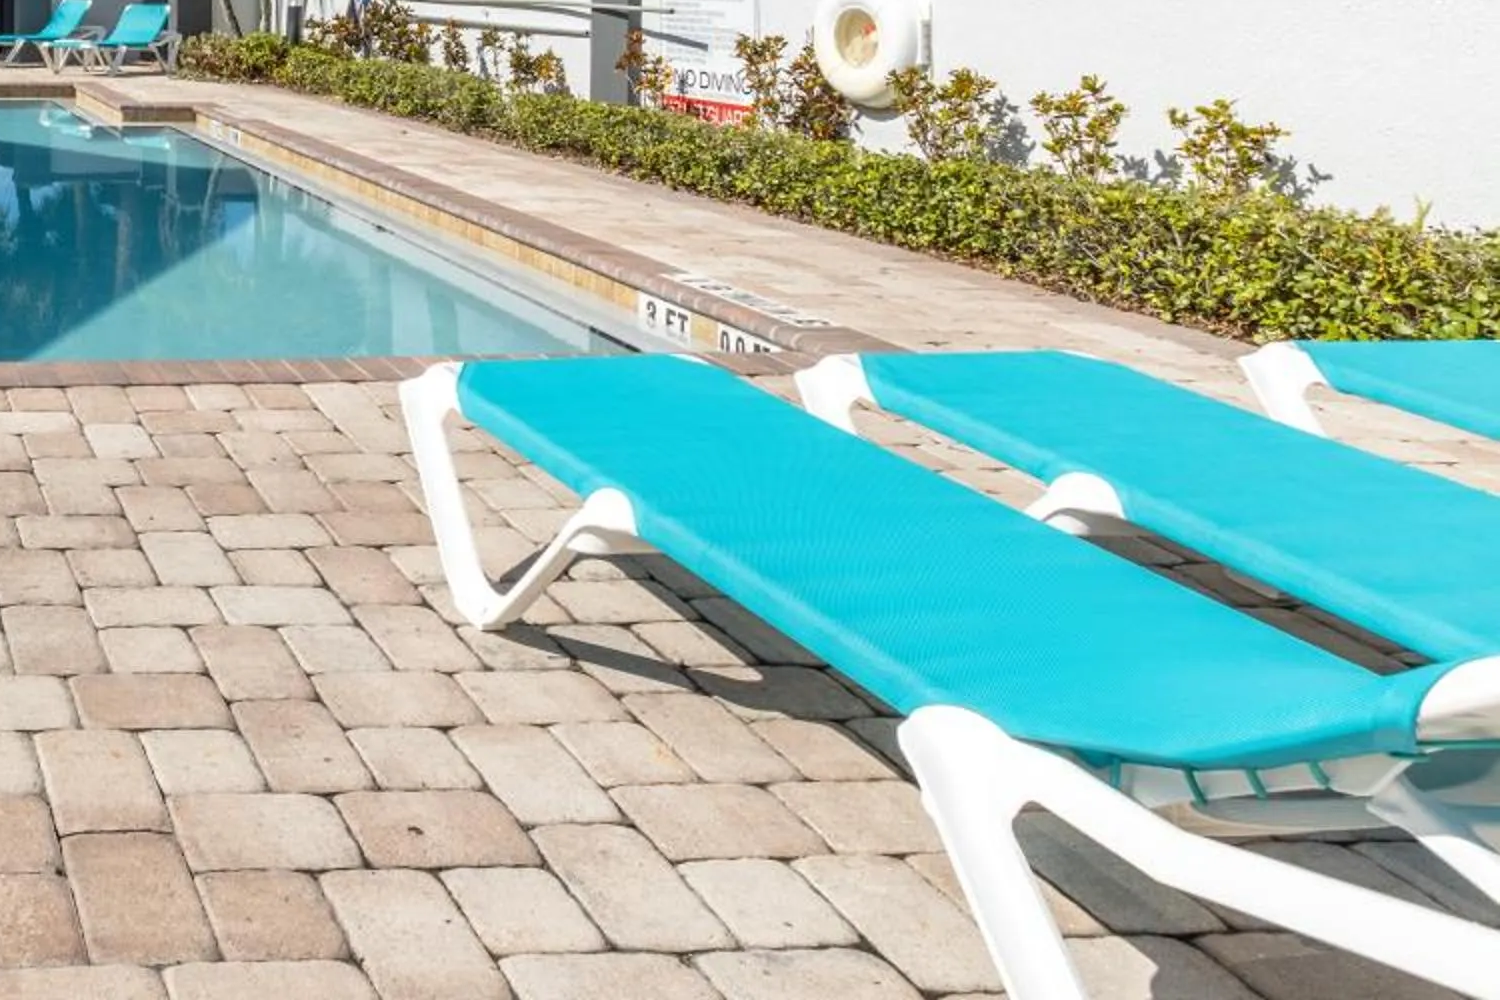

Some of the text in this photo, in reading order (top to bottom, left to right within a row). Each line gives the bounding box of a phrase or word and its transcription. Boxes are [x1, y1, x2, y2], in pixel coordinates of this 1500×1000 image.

[673, 67, 752, 95] NO DIVING
[665, 307, 689, 334] FT
